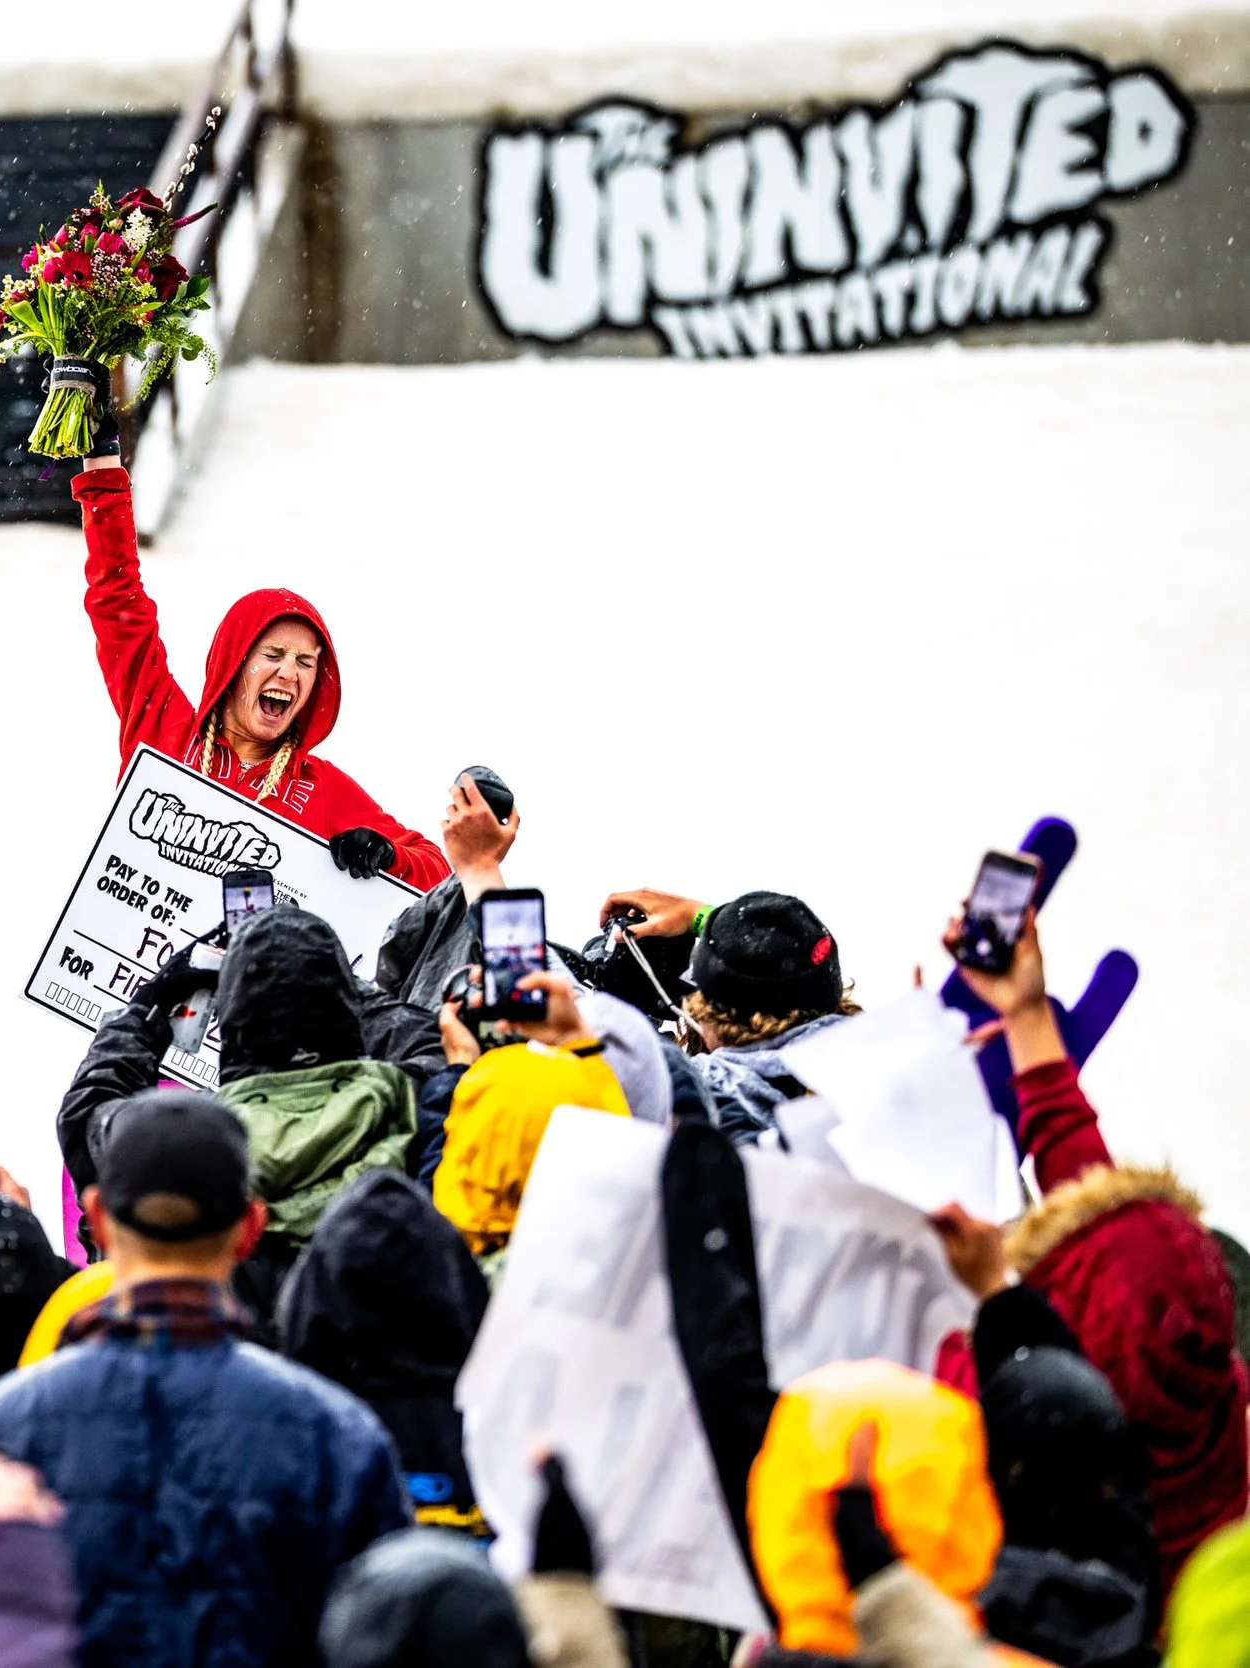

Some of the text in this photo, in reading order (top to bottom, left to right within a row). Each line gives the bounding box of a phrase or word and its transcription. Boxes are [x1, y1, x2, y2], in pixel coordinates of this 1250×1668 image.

[479, 48, 1186, 340] UNINVITED
[654, 222, 1104, 357] INVITATIONAL
[130, 789, 281, 869] UNINVITED
[162, 796, 185, 814] THE
[104, 854, 193, 913] PAY TO THE
[159, 842, 249, 878] INVITATION
[96, 875, 176, 927] ORDER OF:
[272, 878, 299, 895] ESENTED
[58, 946, 94, 981] FOR
